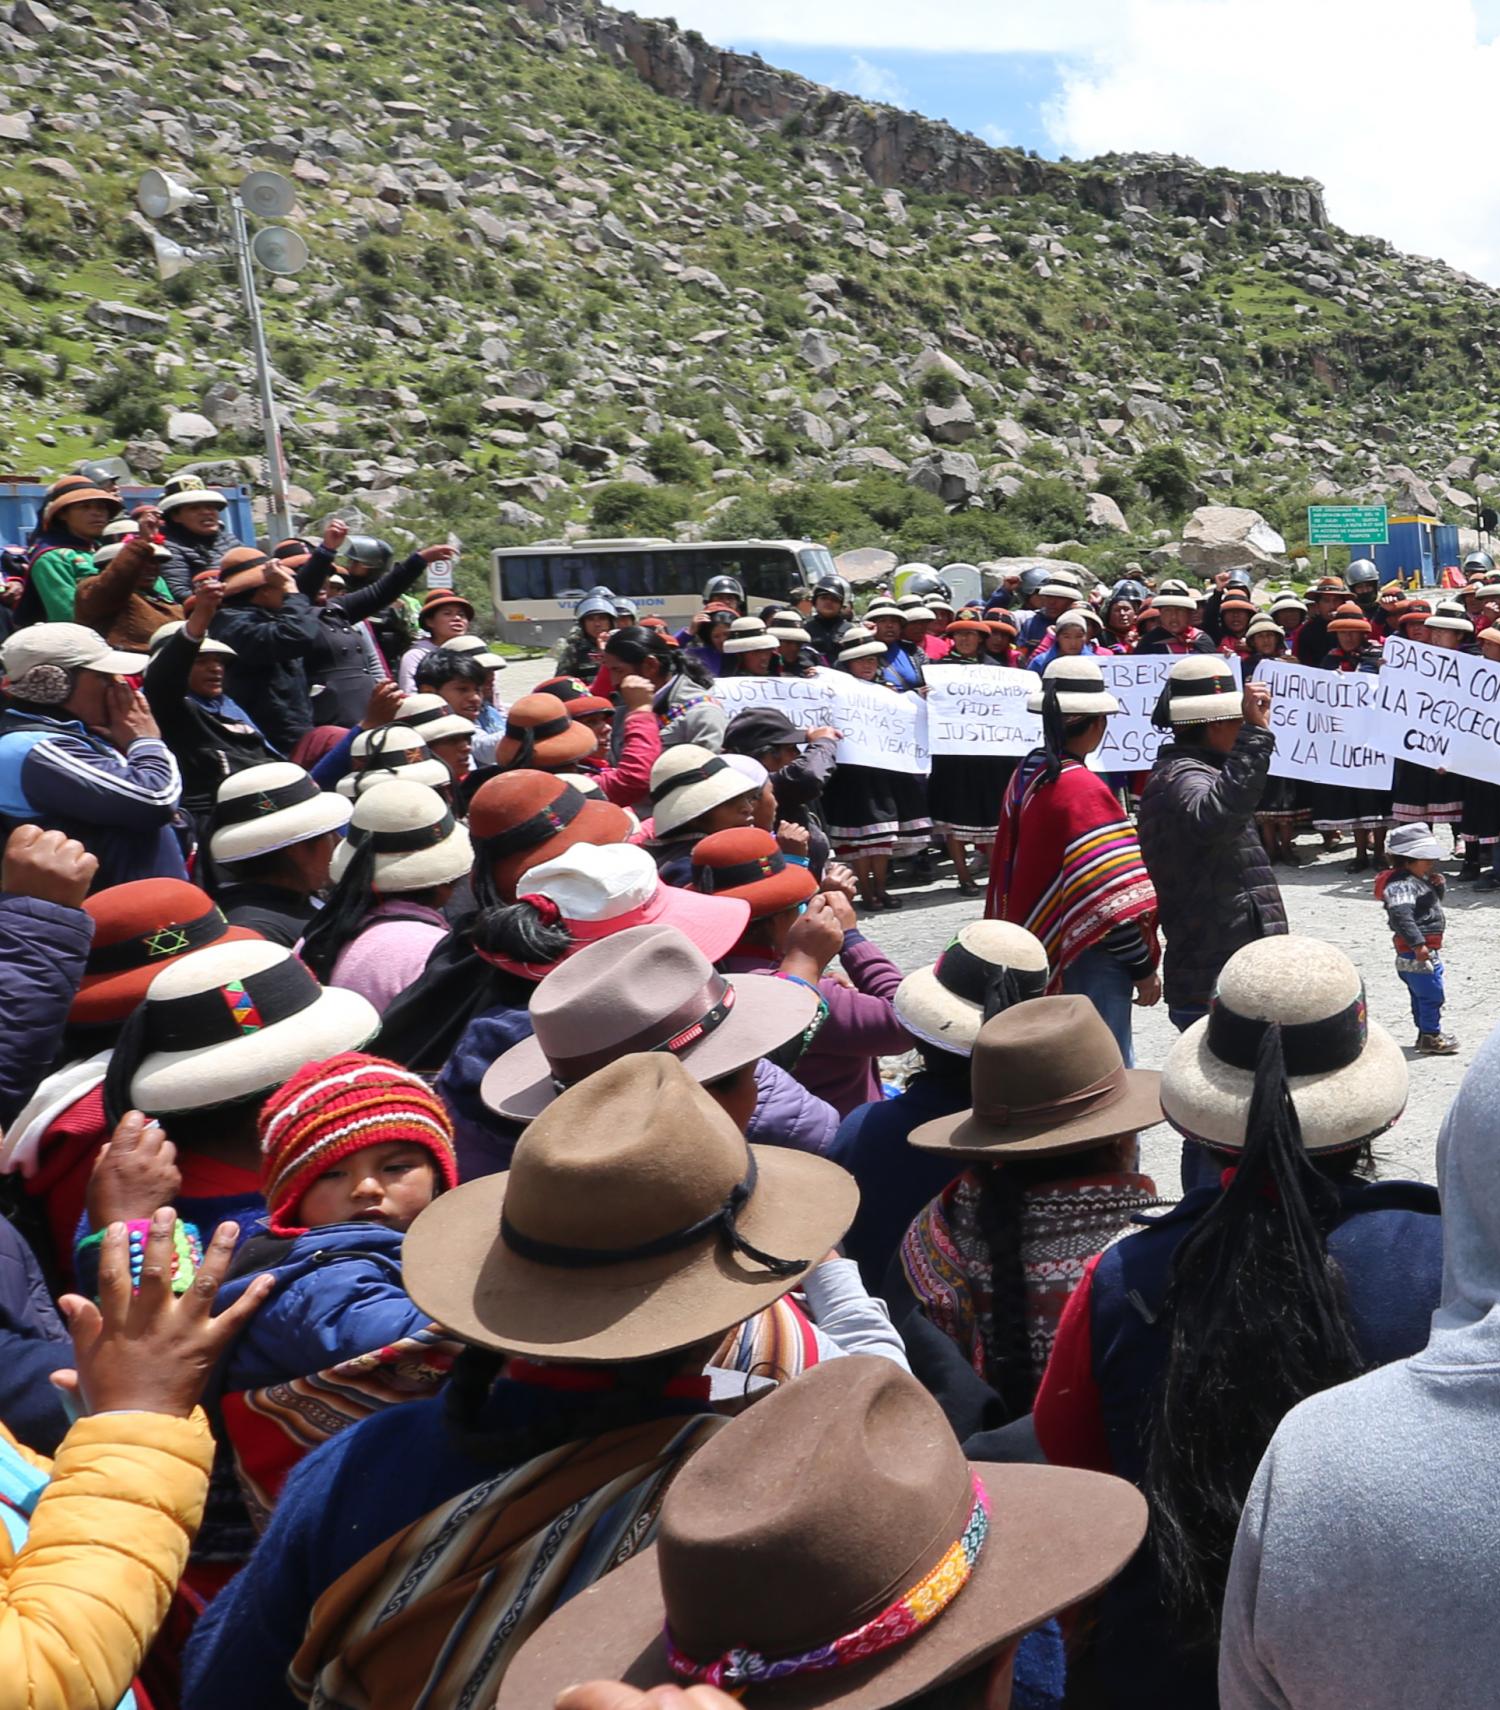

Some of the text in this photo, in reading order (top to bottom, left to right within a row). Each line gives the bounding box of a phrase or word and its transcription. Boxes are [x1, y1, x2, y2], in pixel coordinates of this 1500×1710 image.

[1387, 639, 1461, 688] BASTA
[956, 698, 1004, 716] PIDE
[1381, 685, 1408, 716] LA
[836, 707, 906, 735] JAMAS
[1272, 704, 1345, 734] SE UNE
[1290, 738, 1319, 765] LA
[1330, 739, 1387, 768] LUCHA
